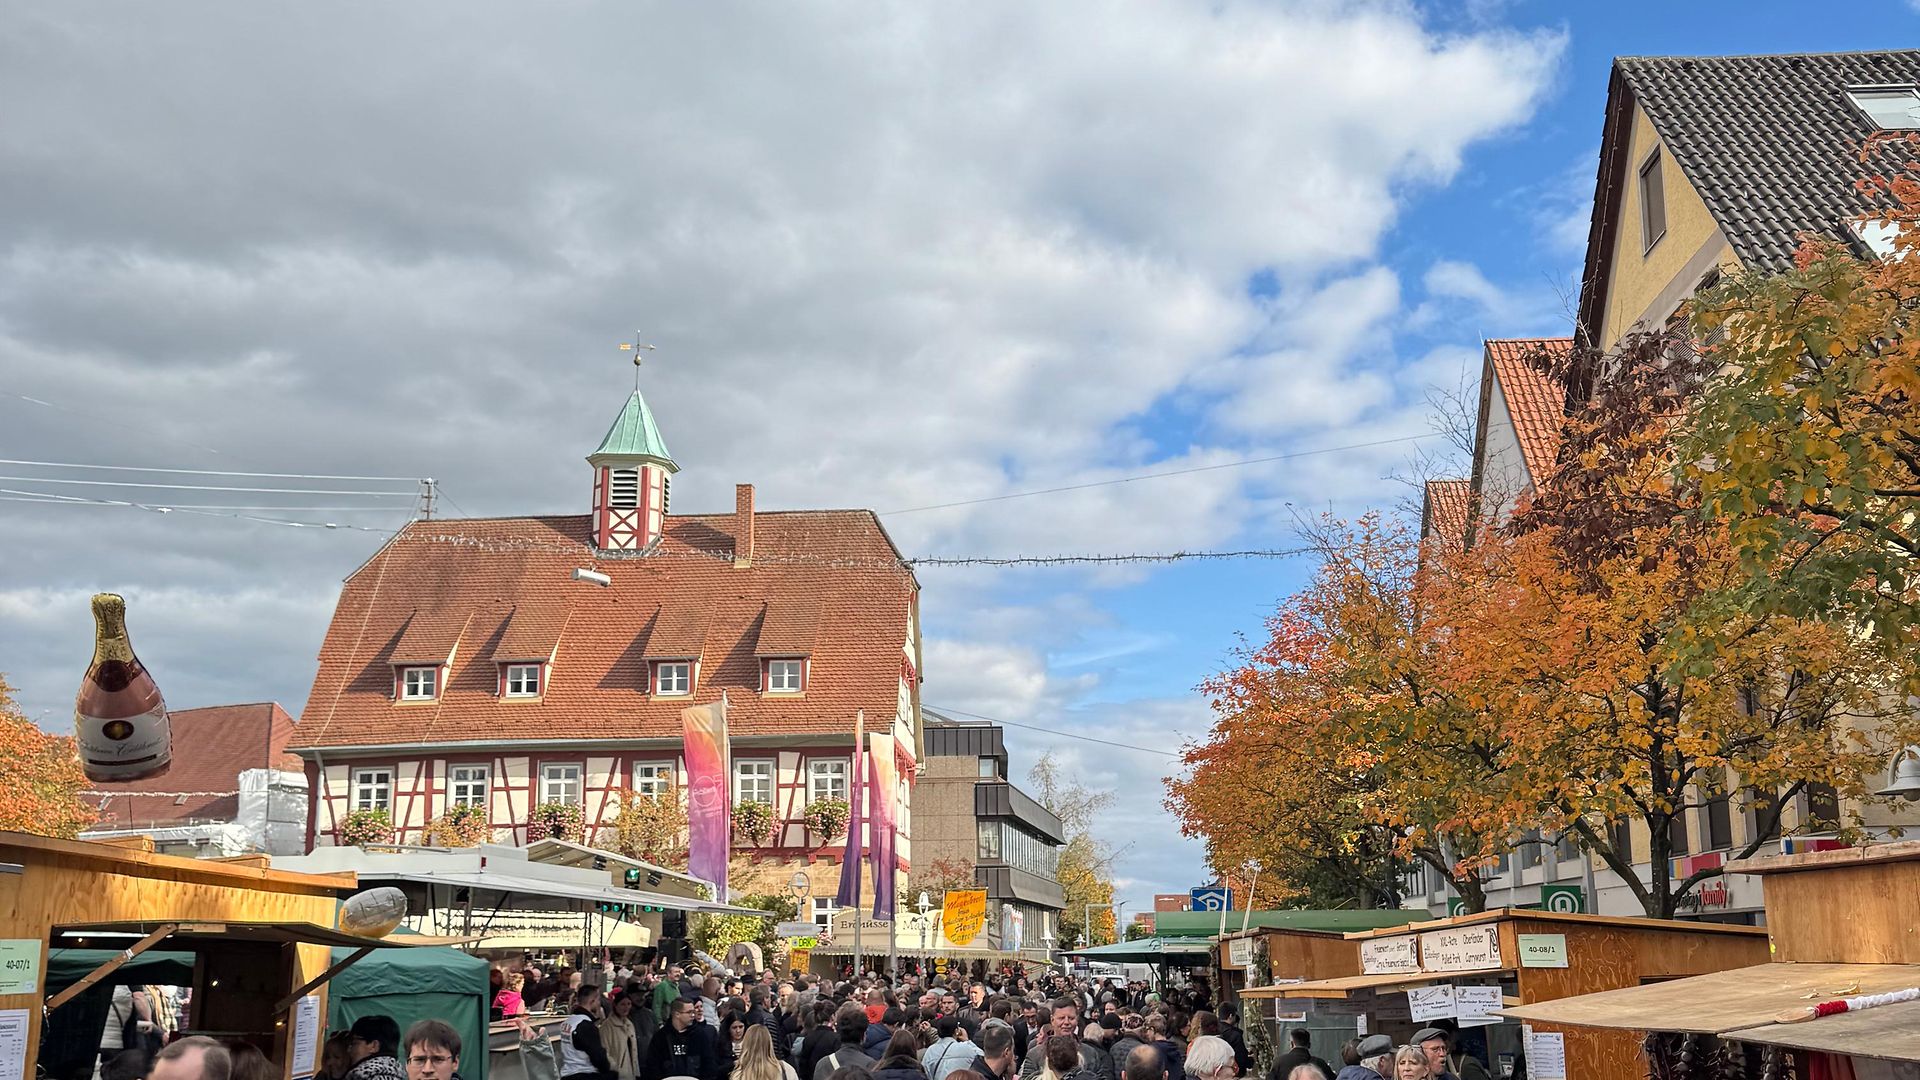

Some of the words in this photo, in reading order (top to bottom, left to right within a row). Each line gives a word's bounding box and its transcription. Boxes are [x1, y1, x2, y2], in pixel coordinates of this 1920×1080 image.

[1701, 880, 1728, 909] family
[798, 937, 813, 947] DRK
[1528, 946, 1555, 954] 40-08/1
[6, 958, 30, 971] 40-07/1
